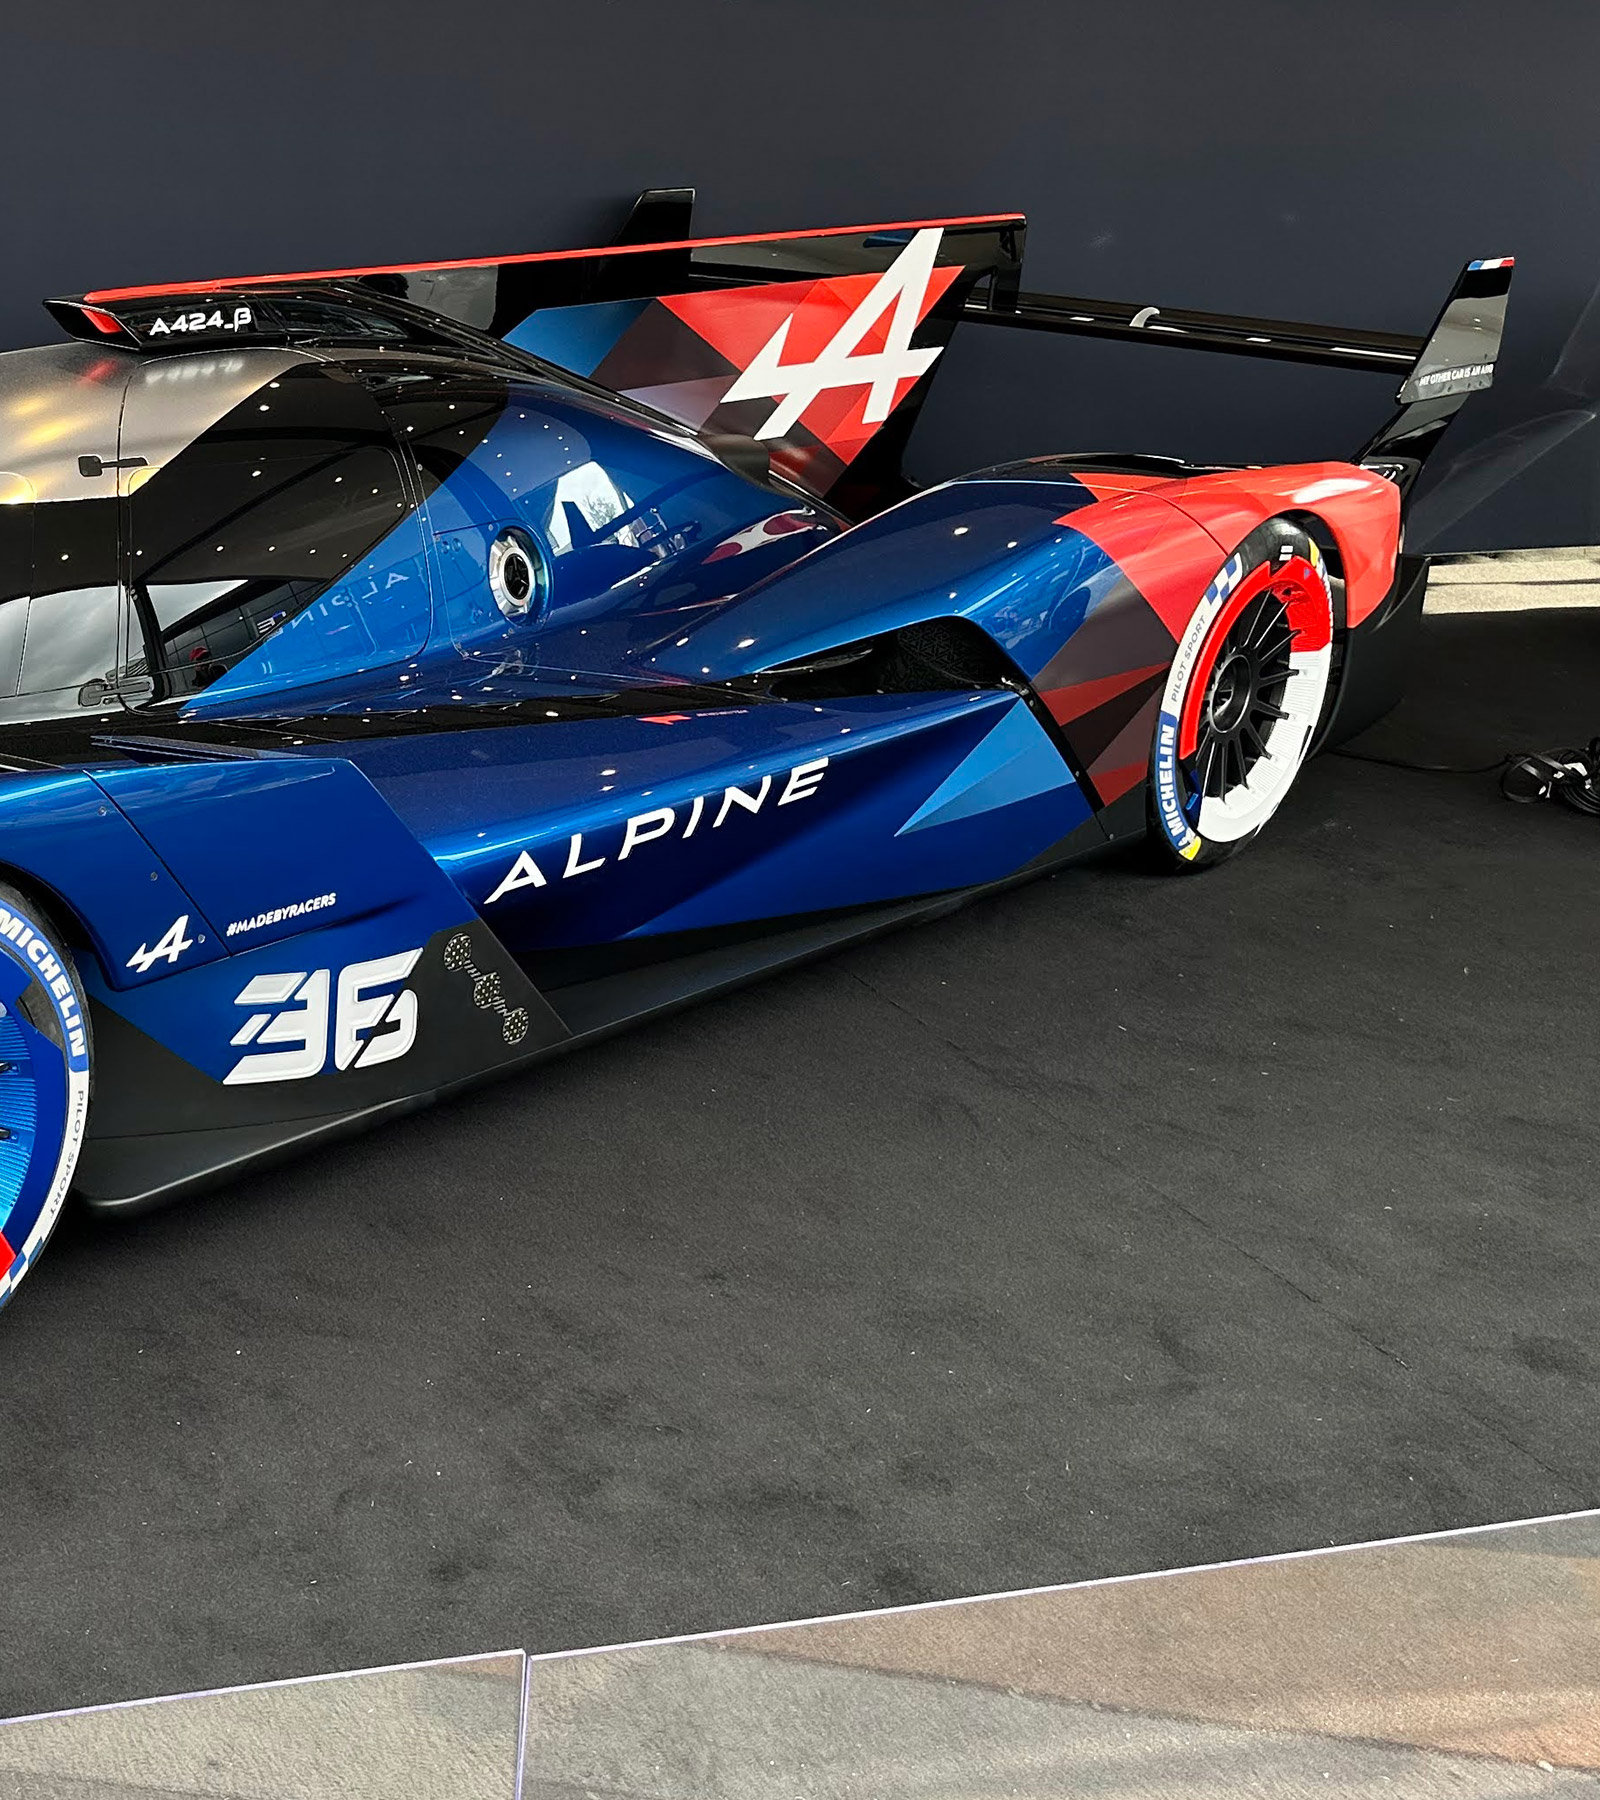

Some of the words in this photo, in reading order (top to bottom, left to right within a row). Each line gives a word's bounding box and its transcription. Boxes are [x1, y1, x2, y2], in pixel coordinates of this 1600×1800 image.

[1451, 369, 1464, 380] CAR
[1171, 661, 1187, 702] PILOT
[1184, 615, 1206, 660] SPORT
[1159, 724, 1186, 837] MICHELIN
[483, 757, 829, 904] ALPINE
[226, 892, 337, 937] #MADEBYRACERS
[223, 947, 424, 1086] 36
[72, 1090, 85, 1146] PILOT
[50, 1151, 75, 1220] SPORT
